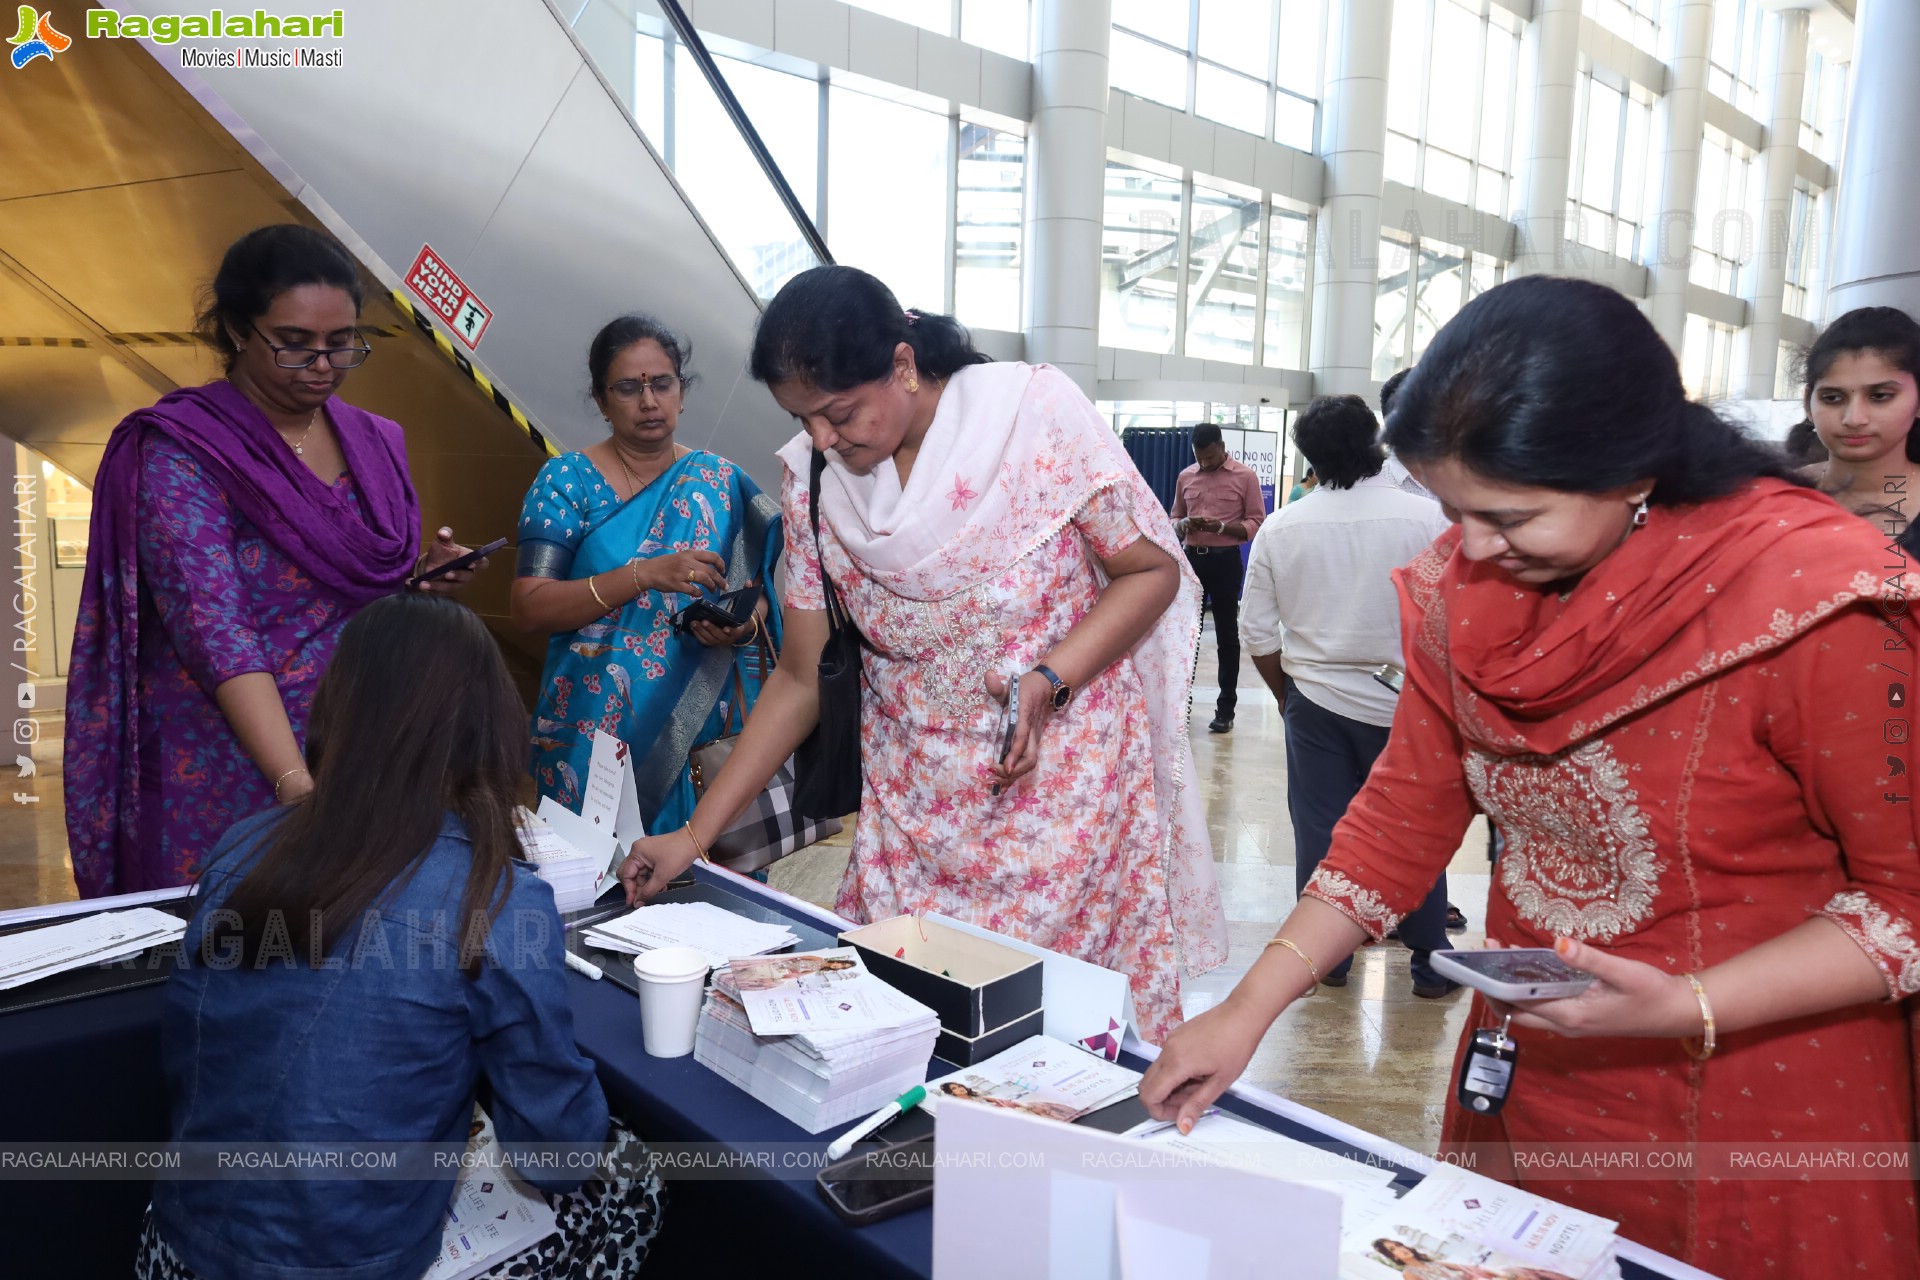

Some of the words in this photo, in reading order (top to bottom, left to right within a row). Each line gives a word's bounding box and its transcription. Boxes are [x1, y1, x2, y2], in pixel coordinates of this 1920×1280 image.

[420, 263, 459, 309] YOUR
[425, 256, 463, 298] MIND
[412, 274, 453, 317] HEAD
[1244, 451, 1258, 461] NO
[1260, 452, 1274, 462] NO
[1260, 464, 1273, 474] VO
[468, 1190, 486, 1212] LIFE
[484, 1223, 500, 1240] IFE
[1549, 1222, 1581, 1256] NOVOTEL
